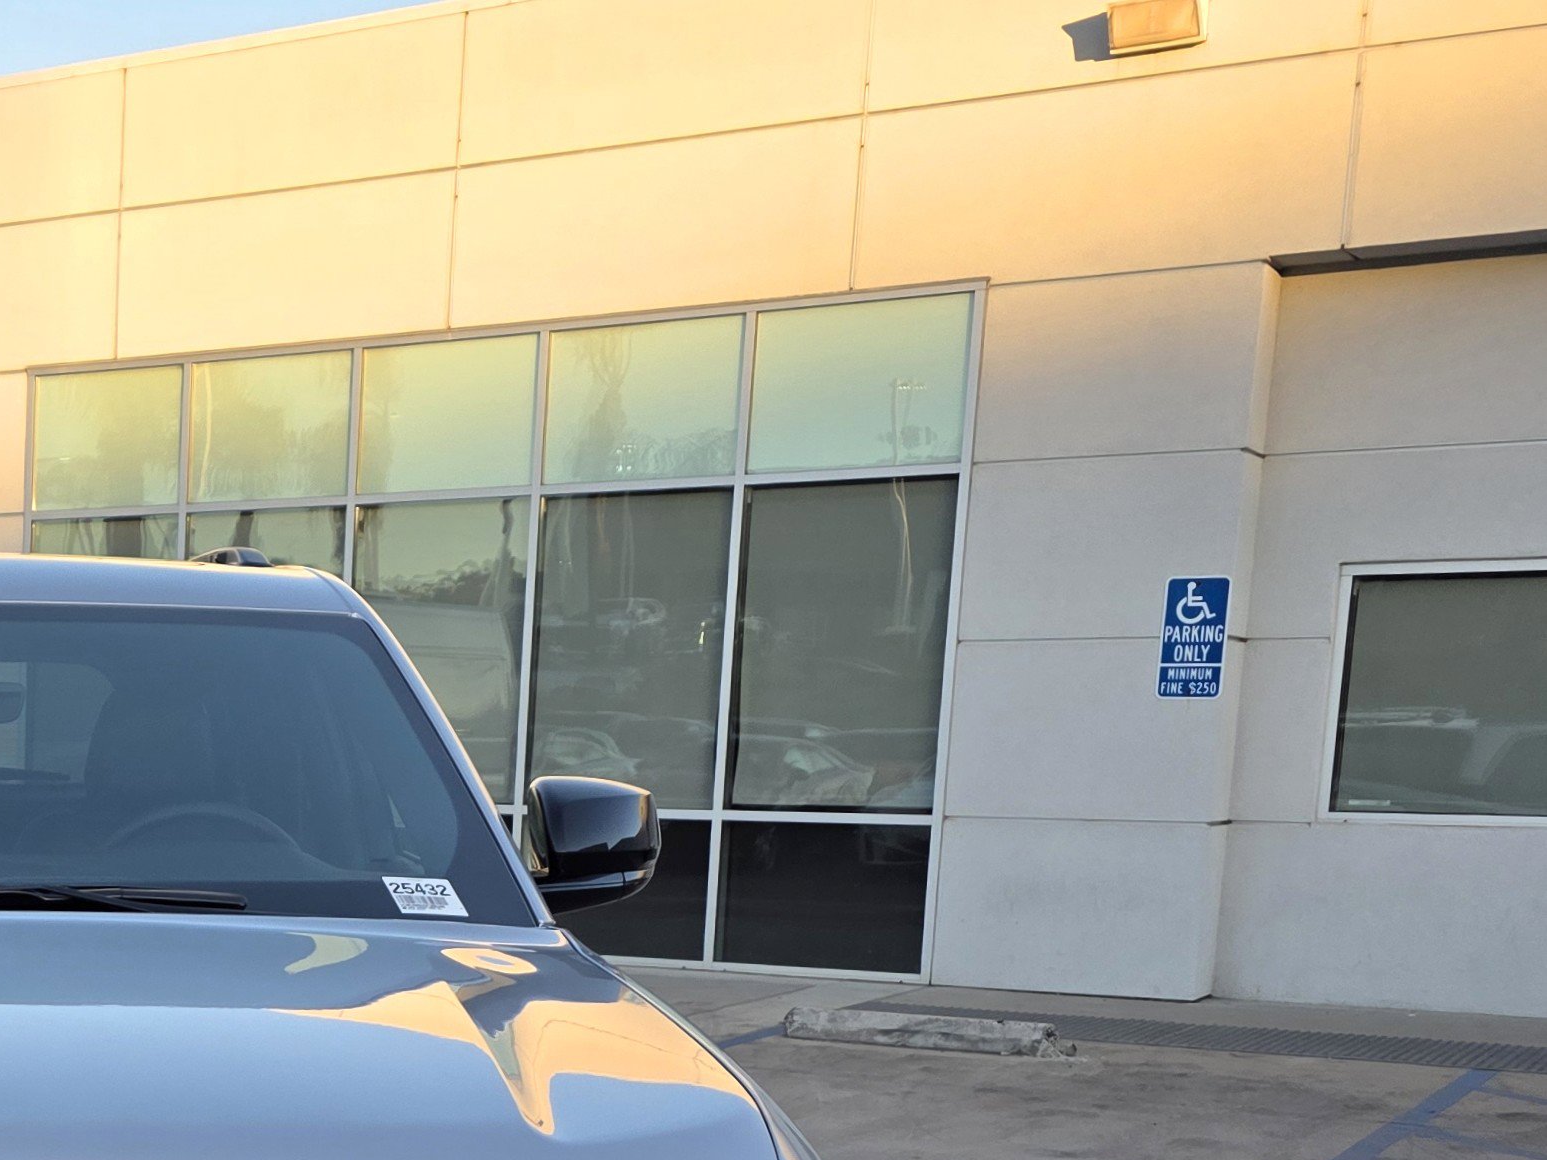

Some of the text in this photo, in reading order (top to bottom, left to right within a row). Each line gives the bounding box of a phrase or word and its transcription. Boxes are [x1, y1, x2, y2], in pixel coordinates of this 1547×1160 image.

[1164, 625, 1224, 643] PARKING
[1173, 644, 1211, 662] ONLY
[1167, 668, 1212, 680] MINIMUM
[1160, 682, 1217, 694] FINE $250
[389, 882, 452, 896] 25432
